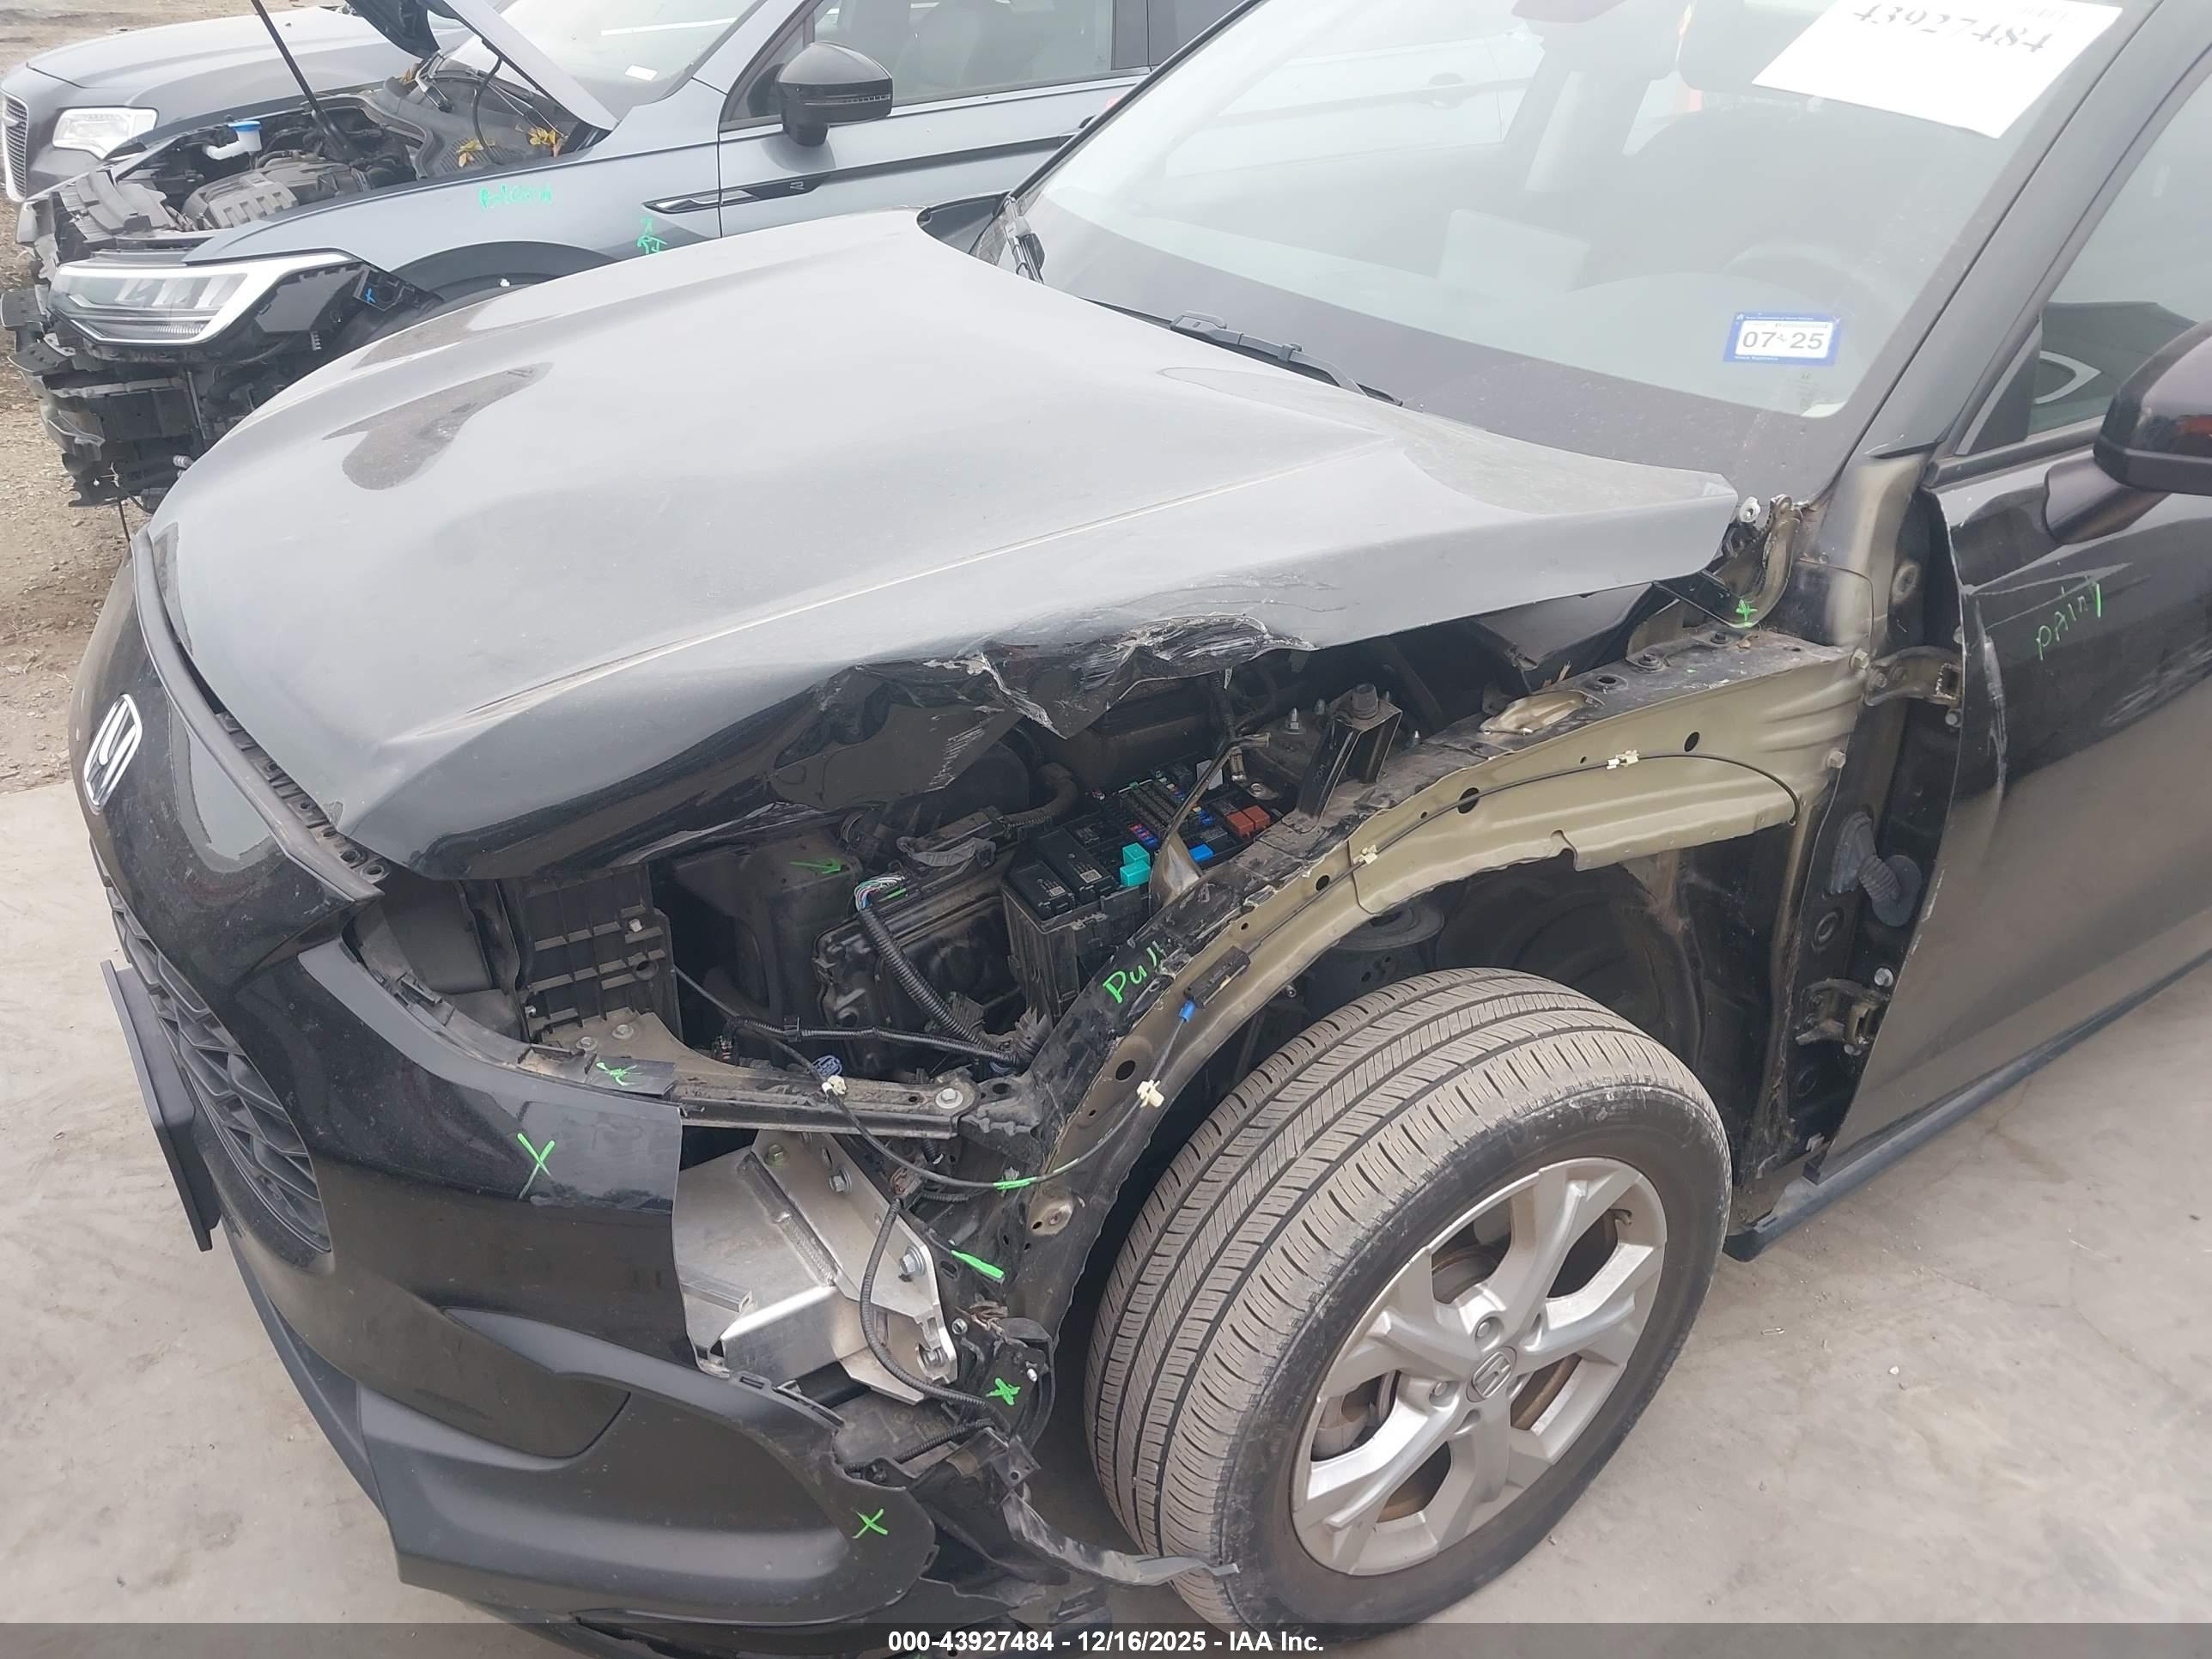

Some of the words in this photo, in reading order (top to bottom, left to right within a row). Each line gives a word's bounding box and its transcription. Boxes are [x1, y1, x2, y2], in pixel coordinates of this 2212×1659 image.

[1852, 3, 2054, 53] 43927484
[1742, 331, 1777, 348] 07
[1789, 331, 1825, 349] 25
